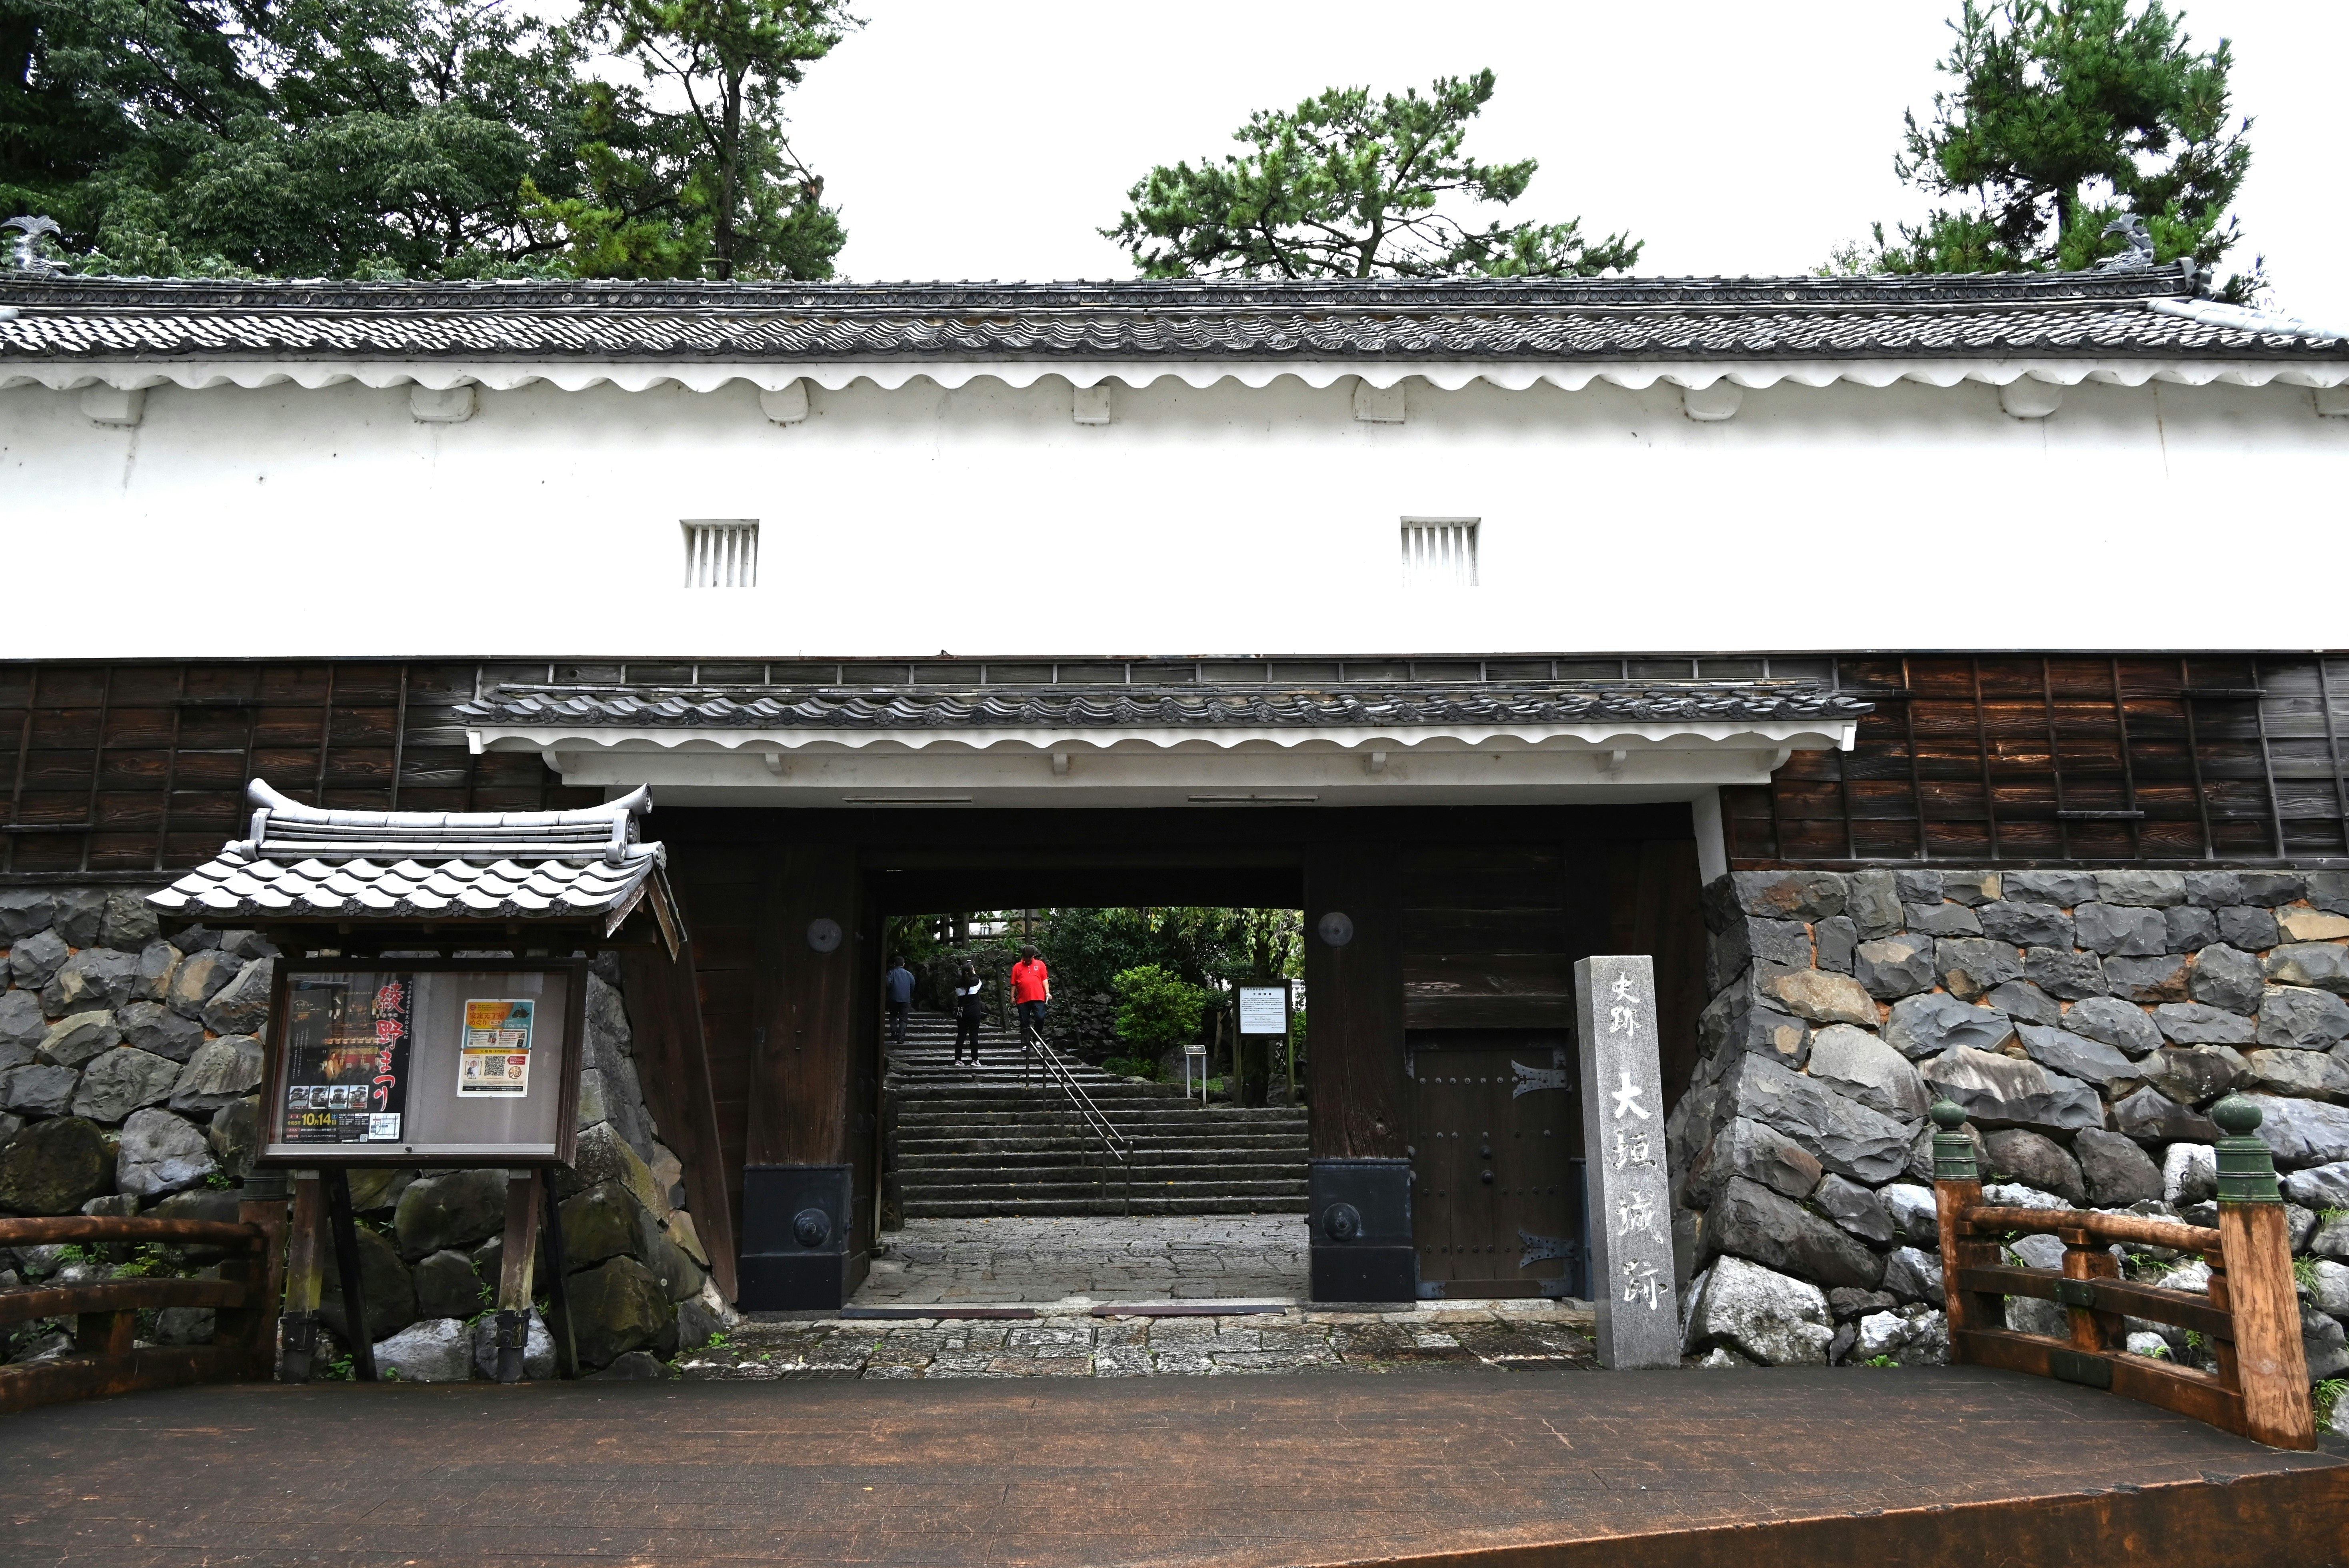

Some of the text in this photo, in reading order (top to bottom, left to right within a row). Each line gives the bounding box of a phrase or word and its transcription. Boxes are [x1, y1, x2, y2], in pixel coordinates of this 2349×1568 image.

[372, 980, 406, 1112] 綾野まつり
[1609, 971, 1669, 1311] 史跡 大垣城跡
